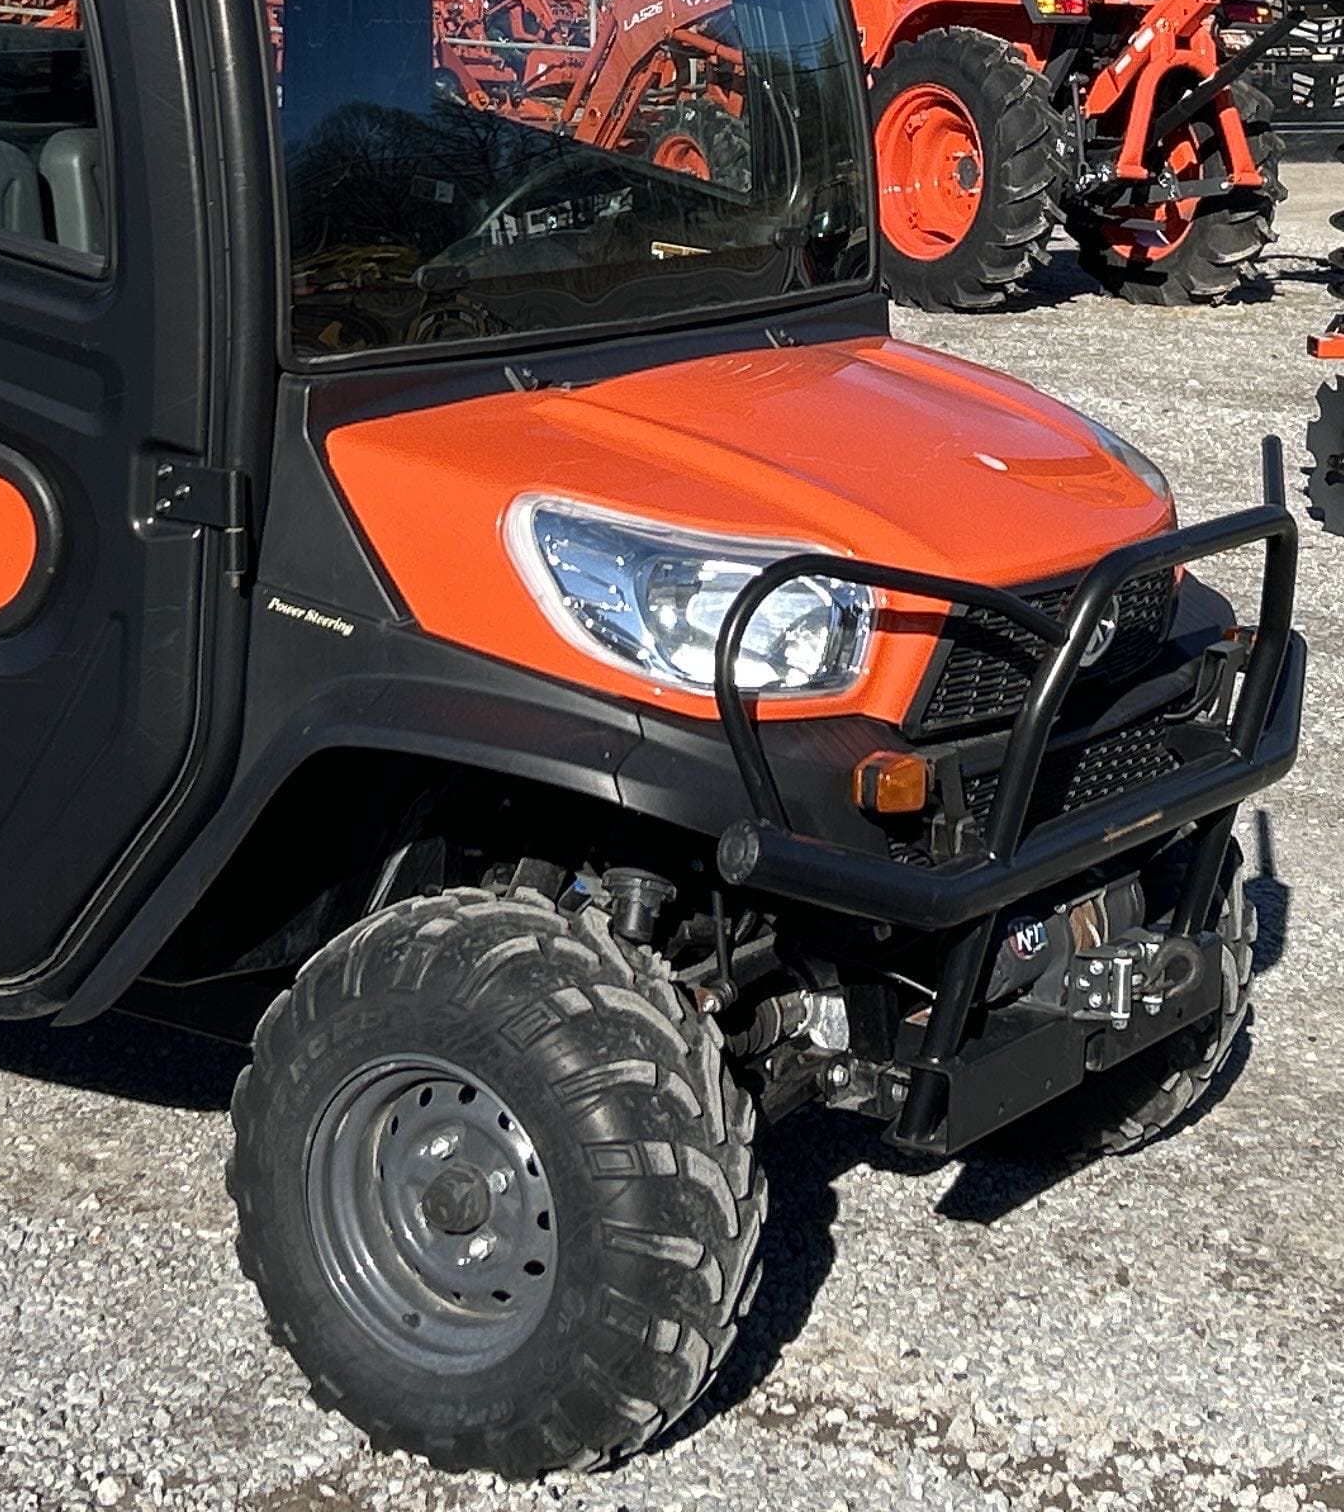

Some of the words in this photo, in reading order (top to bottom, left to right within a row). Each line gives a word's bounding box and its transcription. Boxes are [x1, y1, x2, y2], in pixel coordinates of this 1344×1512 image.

[623, 0, 664, 32] LA526
[268, 597, 306, 619] Power
[304, 609, 354, 637] Steering
